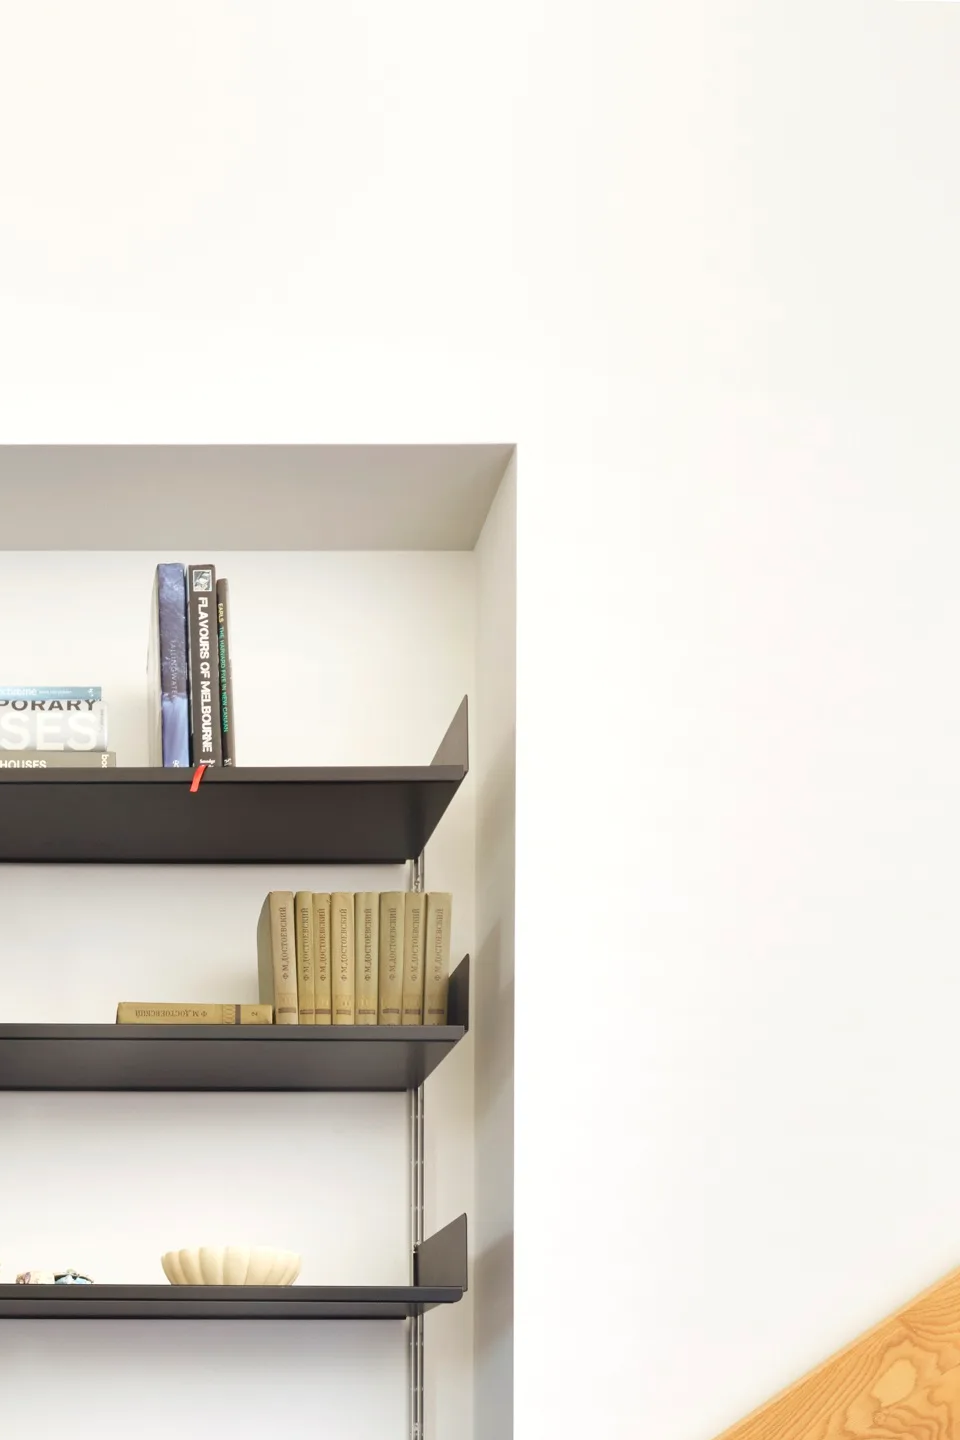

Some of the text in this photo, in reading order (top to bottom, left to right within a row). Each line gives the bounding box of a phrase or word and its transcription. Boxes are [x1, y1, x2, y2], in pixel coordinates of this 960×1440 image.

[198, 597, 209, 660] FLAVOURS
[200, 662, 210, 680] OF
[201, 680, 213, 752] MELBOURNE
[0, 759, 47, 768] HOUSES
